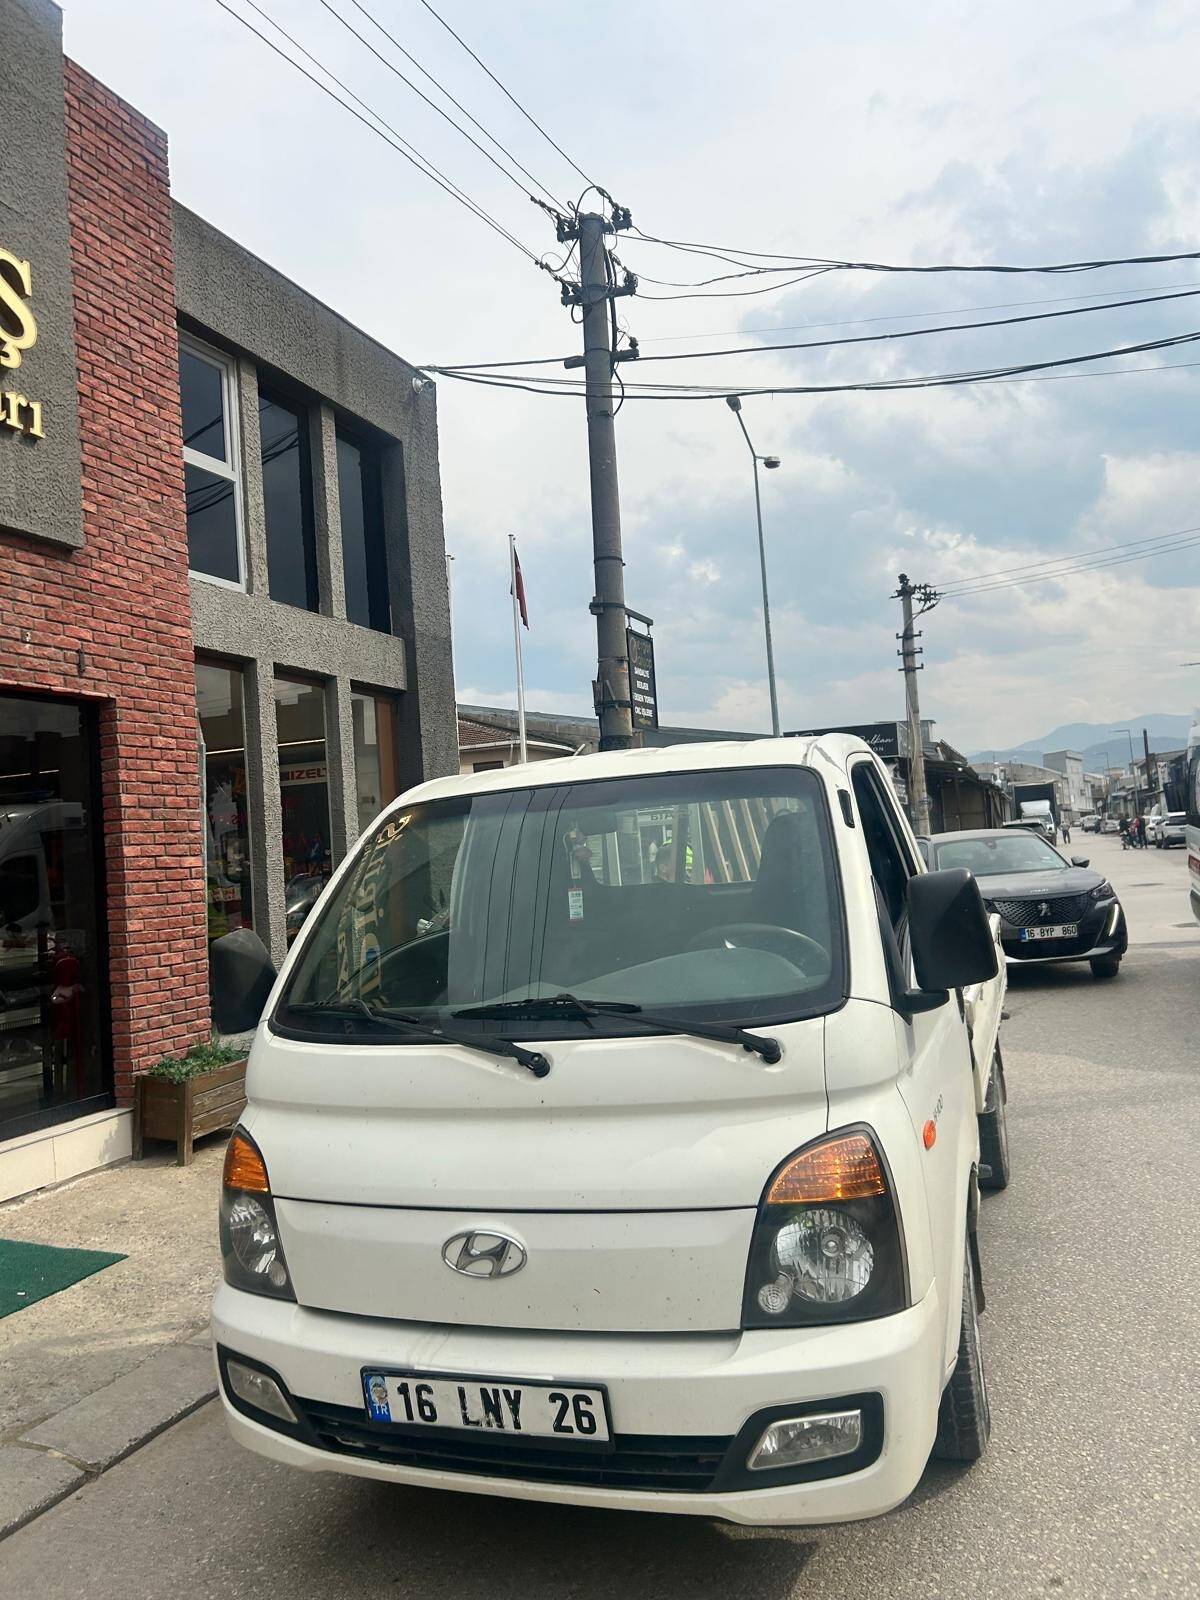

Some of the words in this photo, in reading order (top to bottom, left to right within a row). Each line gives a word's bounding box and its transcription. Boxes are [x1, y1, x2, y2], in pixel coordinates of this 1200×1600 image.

[0, 391, 46, 439] rı
[373, 1403, 388, 1415] TR
[397, 1382, 437, 1423] 16
[457, 1386, 522, 1430] LNY
[549, 1392, 597, 1435] 26
